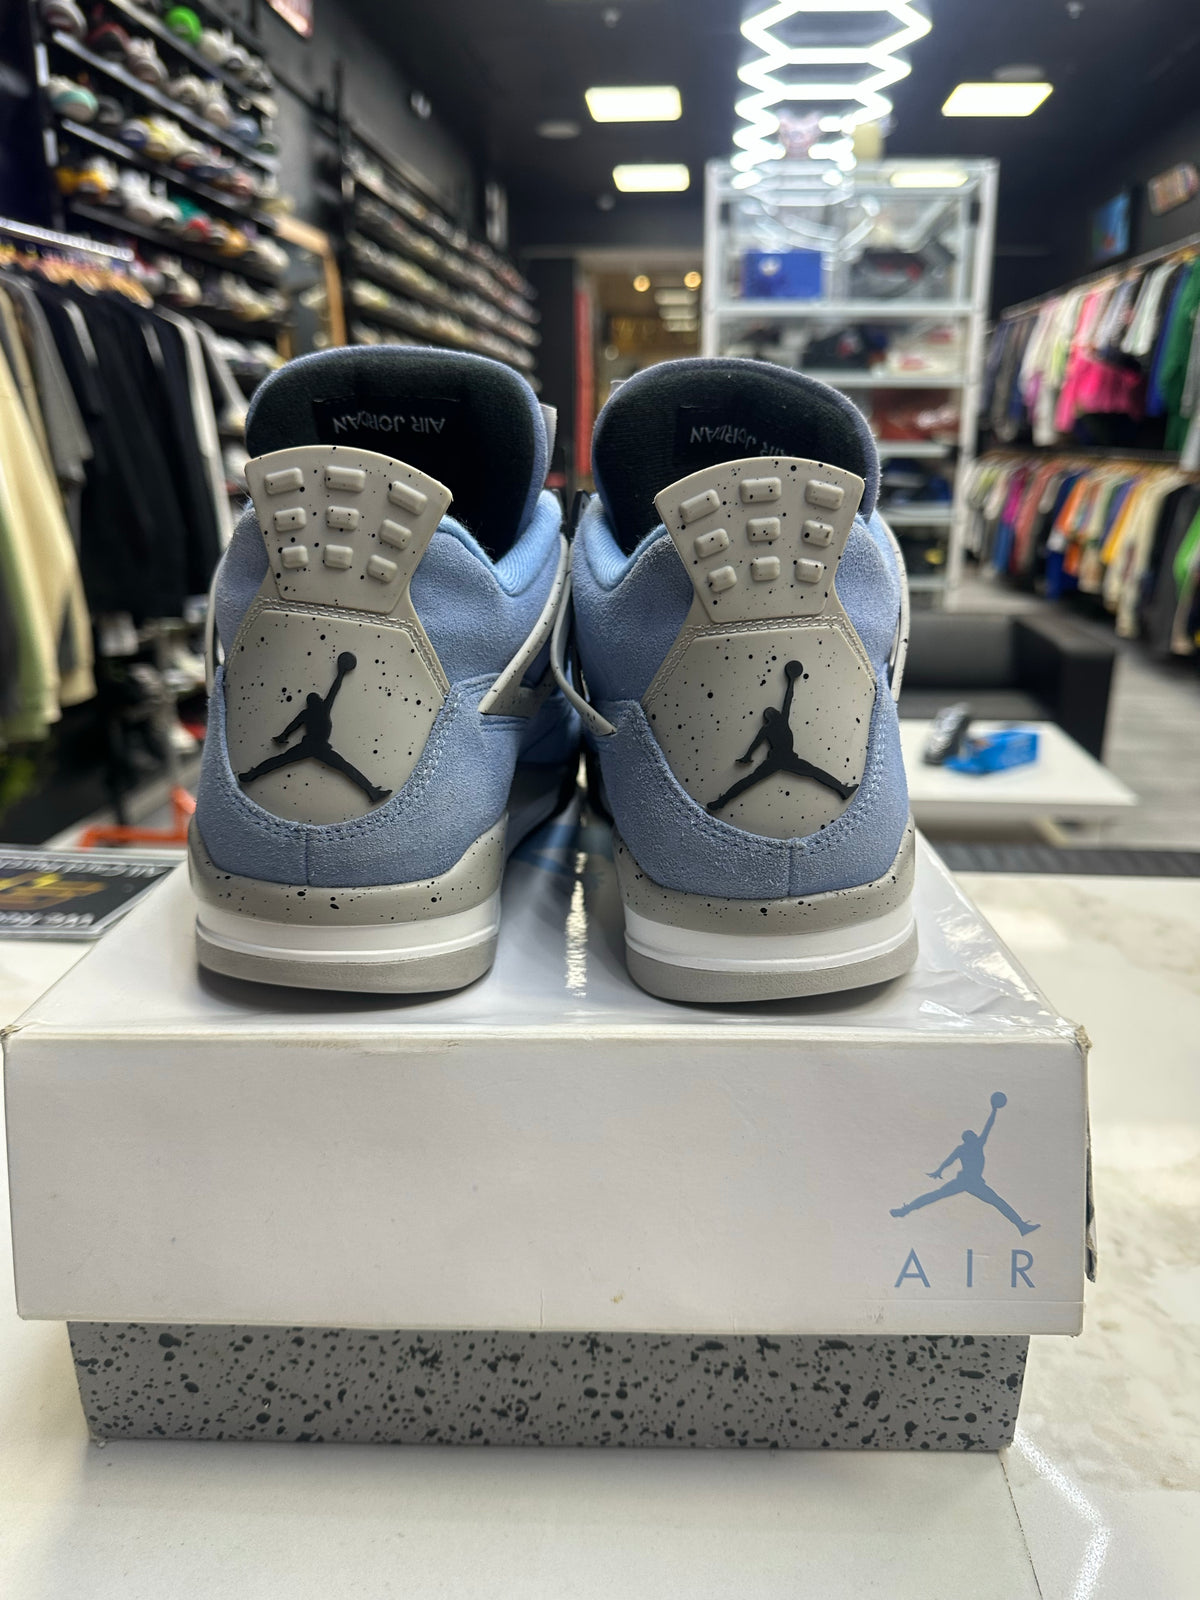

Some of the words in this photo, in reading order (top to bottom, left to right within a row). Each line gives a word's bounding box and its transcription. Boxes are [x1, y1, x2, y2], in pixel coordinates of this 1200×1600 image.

[332, 410, 405, 434] JORDAN
[410, 415, 446, 433] AIR
[690, 424, 756, 449] JORDAN
[894, 1248, 1036, 1288] AIR
